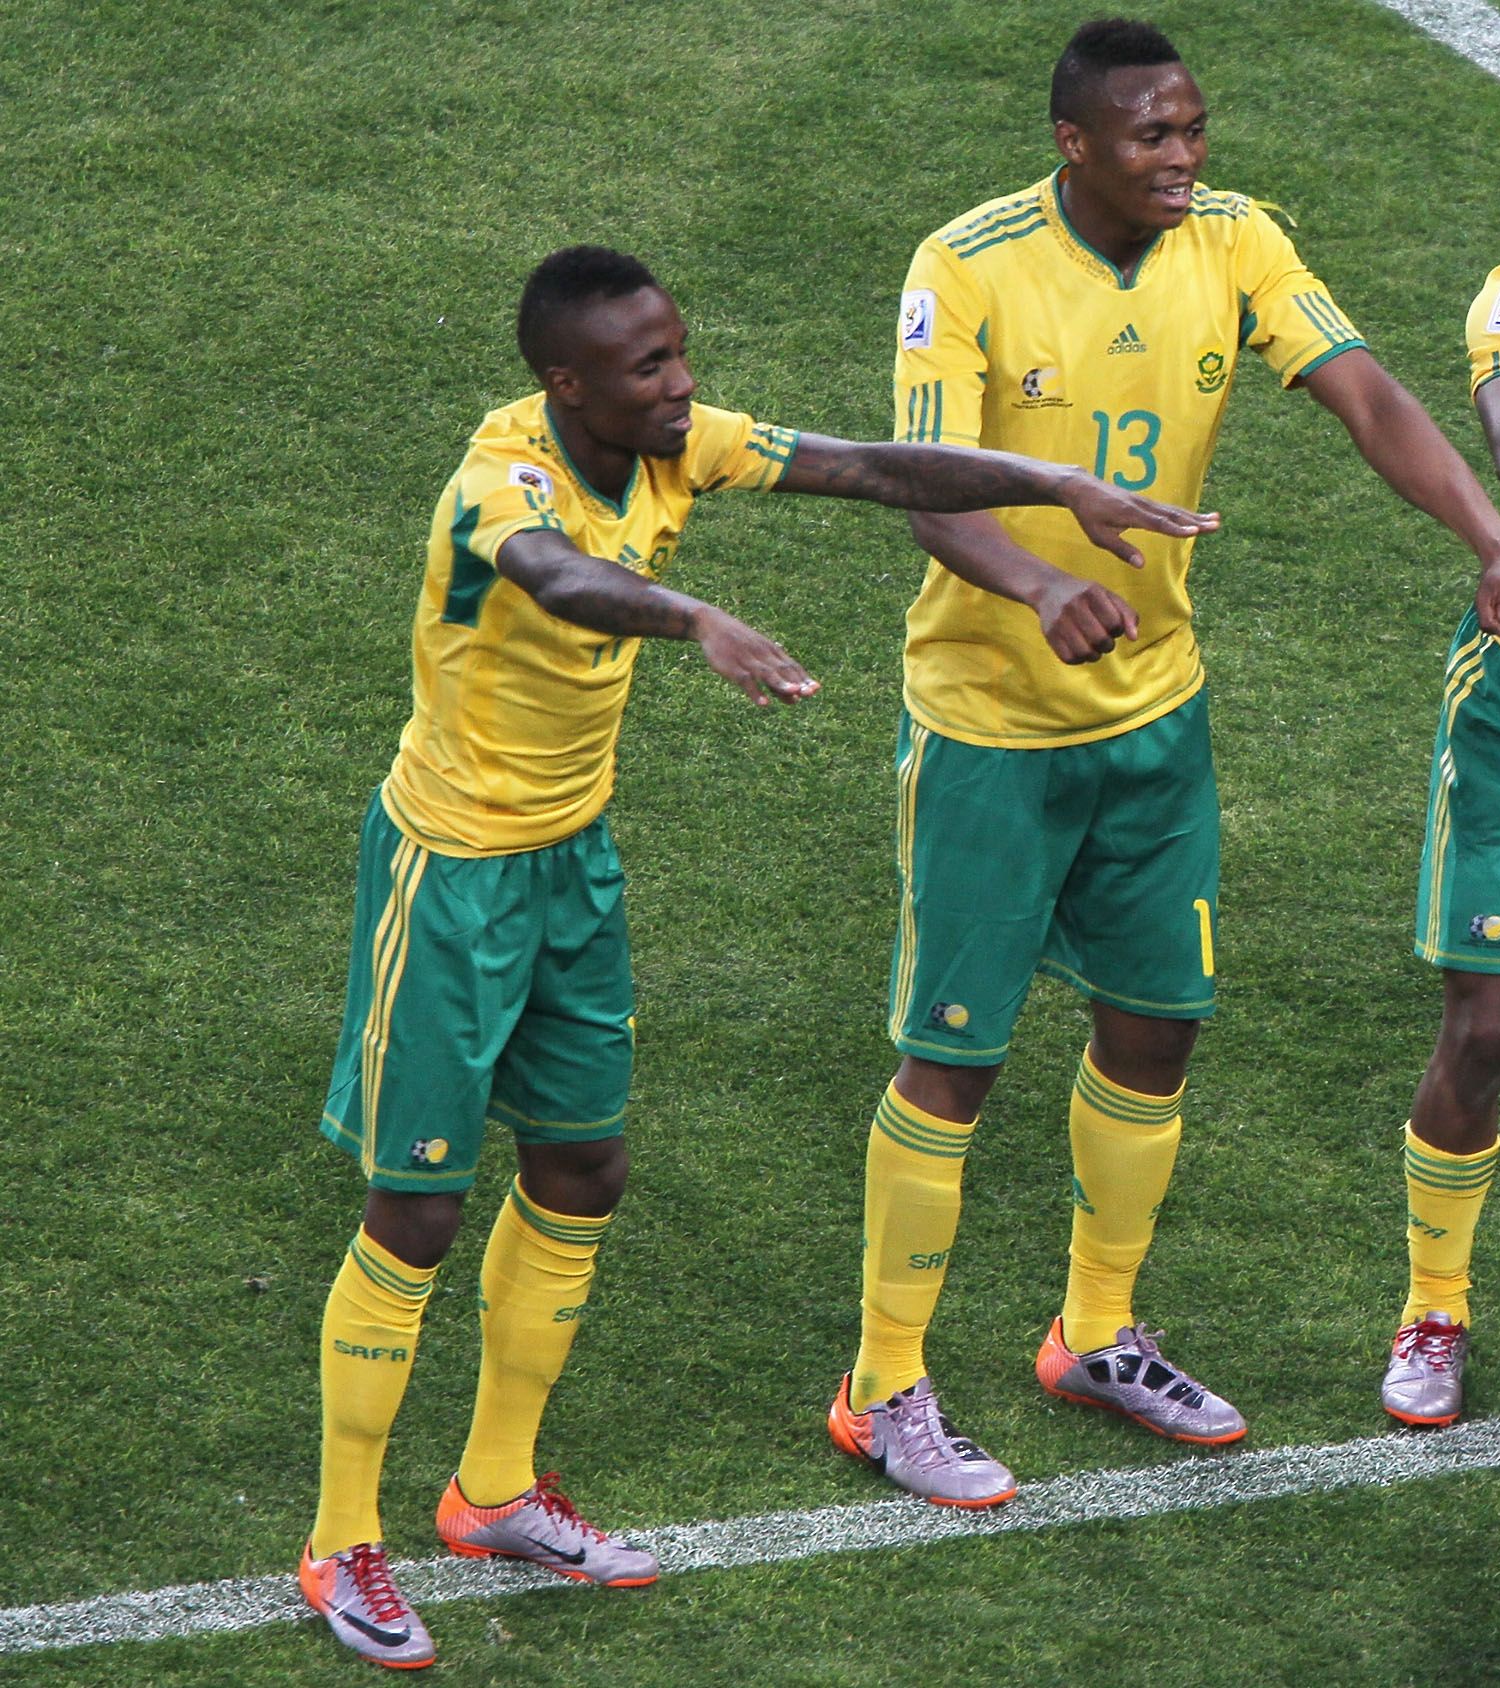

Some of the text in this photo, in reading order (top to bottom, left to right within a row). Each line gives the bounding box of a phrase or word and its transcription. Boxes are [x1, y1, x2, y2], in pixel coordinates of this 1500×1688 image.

[1107, 341, 1147, 355] adidas
[1092, 410, 1162, 492] 13
[334, 1339, 408, 1362] SAFA
